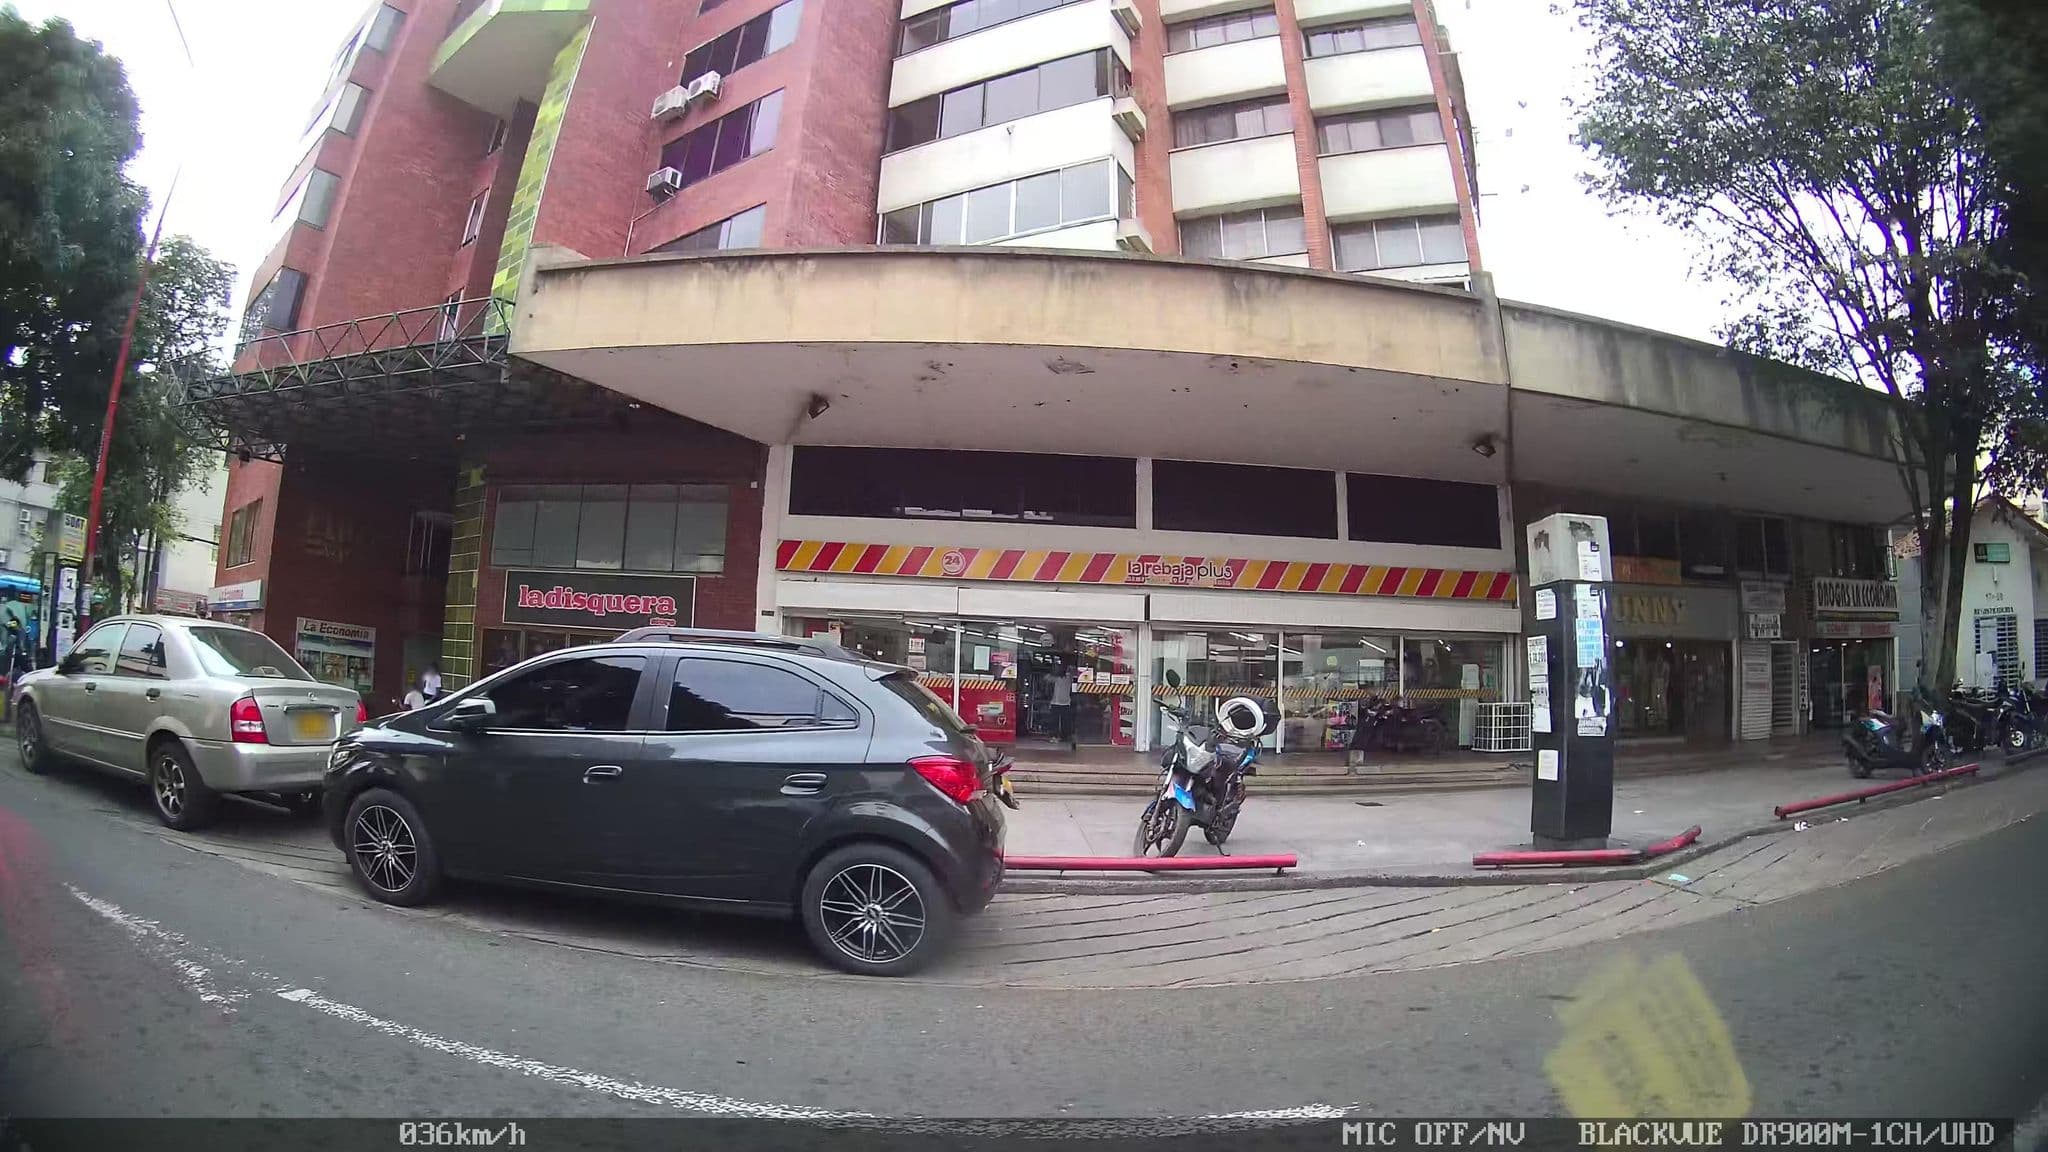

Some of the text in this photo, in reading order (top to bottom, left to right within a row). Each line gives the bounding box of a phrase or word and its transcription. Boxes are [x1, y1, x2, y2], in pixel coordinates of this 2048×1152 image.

[944, 555, 961, 566] 24
[1196, 561, 1233, 581] plus
[518, 584, 678, 616] ladisquera
[1816, 580, 1851, 608] DROGAS
[303, 619, 317, 633] La
